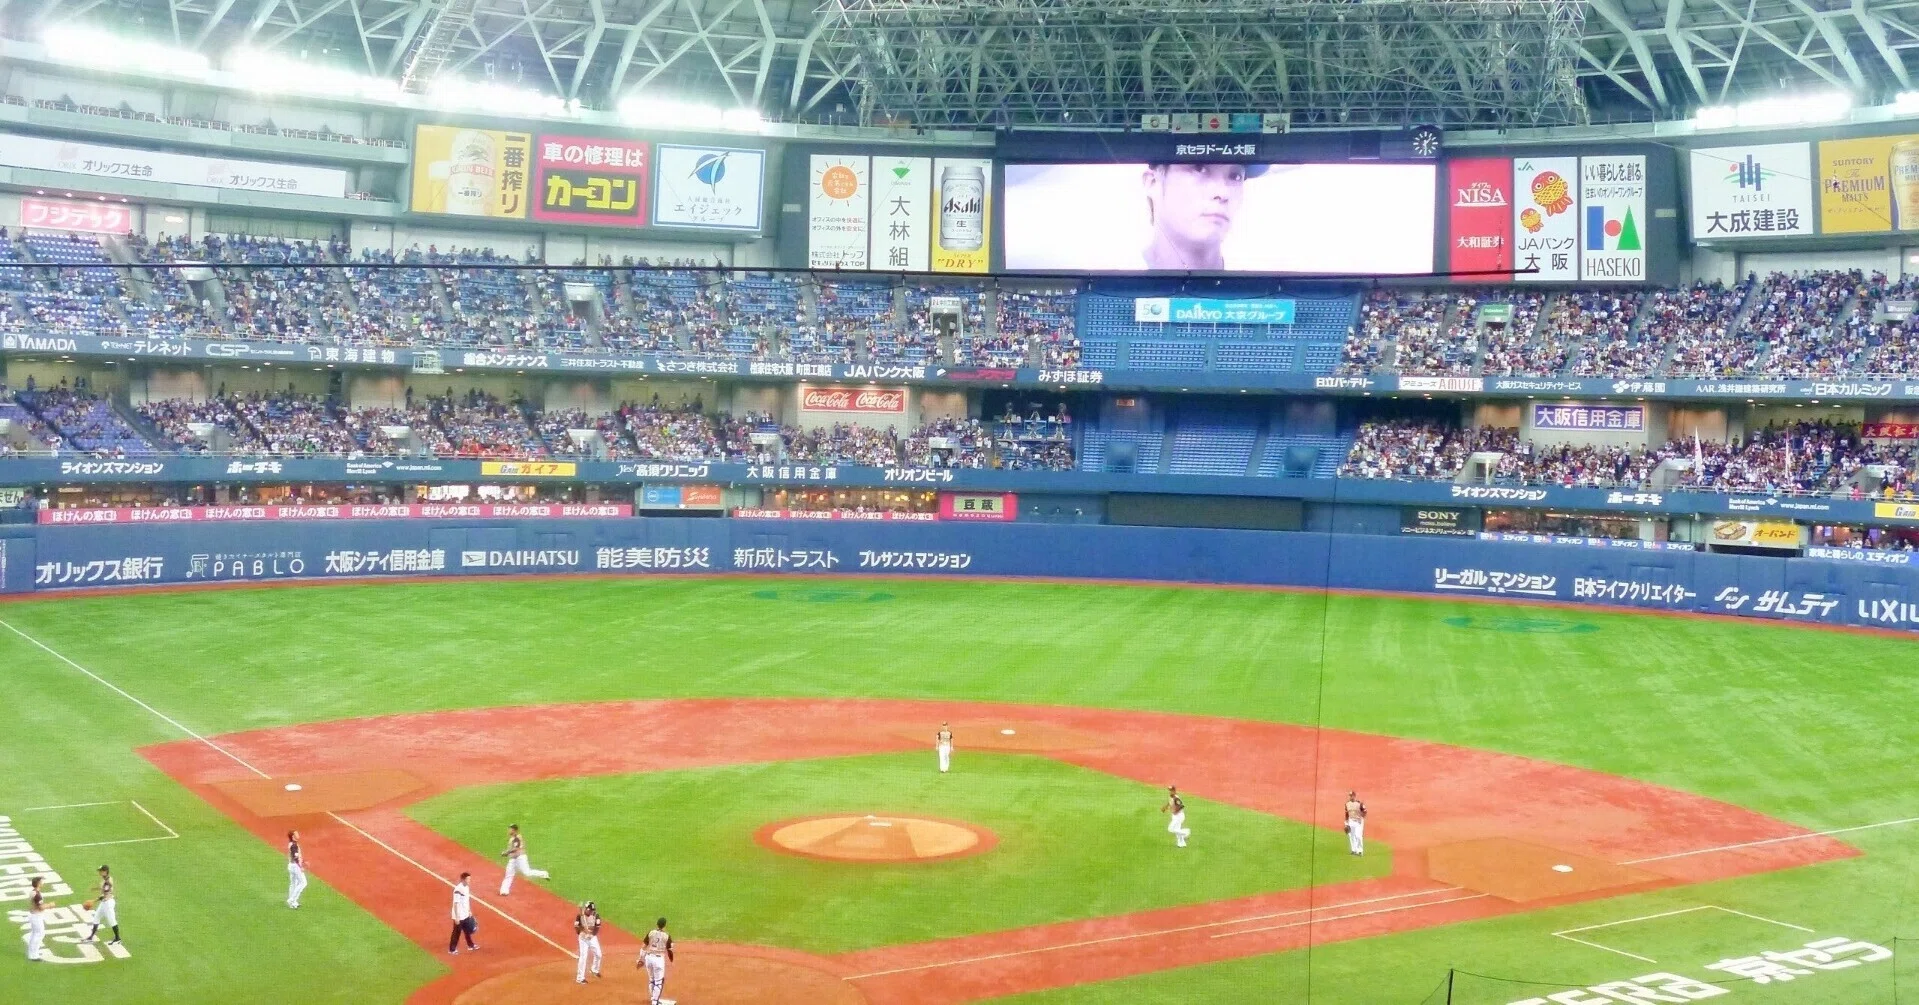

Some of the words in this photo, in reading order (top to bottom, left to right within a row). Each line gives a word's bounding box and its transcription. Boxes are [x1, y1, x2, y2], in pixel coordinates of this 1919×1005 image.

[543, 142, 644, 168] 車の修理は
[82, 159, 153, 177] オリックス生命
[502, 135, 525, 213] 一番搾り
[228, 175, 298, 190] オリックス生命
[1824, 176, 1885, 194] PREMIUM
[547, 175, 636, 210] カーコン
[1457, 188, 1506, 204] NISA
[1733, 193, 1771, 203] TAISEI
[1842, 193, 1869, 203] MALTS
[674, 203, 742, 215] エイジェック
[943, 196, 981, 213] Asahi
[30, 203, 122, 230] フジテック
[1706, 208, 1800, 234] 大成建設
[889, 195, 911, 266] 大林組
[956, 220, 967, 228] 生
[1457, 236, 1504, 249] 大和証券
[1517, 237, 1575, 251] JAバンク
[1524, 252, 1568, 271] 大阪
[1586, 257, 1641, 277] HASEKO
[1225, 311, 1286, 320] 大京グループ
[18, 334, 77, 351] YAMADA
[134, 340, 193, 356] テレネット
[206, 343, 250, 357] CSP
[325, 347, 396, 364] 東海建物
[463, 352, 548, 368] 総合メンテナンス
[560, 358, 645, 370] 三井住友トラスト不動産
[666, 361, 739, 374] さつき株式会社
[844, 365, 925, 379] JAバンク大阪
[1038, 369, 1103, 384] みずほ証券
[1315, 377, 1375, 389] 日立バッテリー
[1402, 380, 1437, 388] アミューズ
[1438, 377, 1478, 391] AMUSE
[1495, 379, 1582, 391] 大阪ガスセキュリティサービス
[1629, 382, 1666, 394] 伊藤園
[1815, 383, 1892, 396] 日本カルミック
[1536, 407, 1642, 428] 大阪信用金庫
[61, 461, 164, 475] ライオンズマンション
[227, 461, 283, 474] ホーチキ
[521, 463, 559, 475] ガイア
[636, 463, 708, 478] 高須クリニック
[746, 466, 837, 480] 大阪信用金庫
[884, 467, 954, 483] オリオンビール
[1451, 485, 1548, 501] ライオンズマンション
[1607, 491, 1663, 506] ホーチキ
[279, 506, 340, 518] ほけんの窓口
[352, 505, 410, 517] ほけんの窓口
[422, 505, 481, 517] ほけんの窓口
[493, 504, 551, 517] ほけんの窓口
[563, 504, 619, 517] ほけんの窓口
[963, 499, 993, 511] 豆蔵
[53, 508, 118, 523] ほけんの窓口
[131, 508, 193, 520] ほけんの窓口
[206, 507, 265, 519] ほけんの窓口
[738, 510, 781, 518] ほけんの窓口
[790, 511, 832, 519] ほけんの窓口
[841, 511, 884, 520] ほけんの窓口
[892, 512, 934, 521] ほけんの窓口
[1417, 510, 1460, 520] SONY
[1502, 534, 1529, 542] エディオン
[1556, 537, 1583, 545] エディオン
[1611, 540, 1639, 548] エディオン
[1666, 543, 1694, 551] エディオン
[325, 549, 445, 573] 大阪シティ信用金庫
[489, 550, 579, 567] DAIHATSU
[596, 547, 710, 569] 能美防災
[733, 547, 840, 569] 新成トラスト
[858, 550, 972, 569] プレサンスマンション
[1866, 551, 1909, 564] エディオン
[36, 556, 164, 584] オリックス銀行
[213, 558, 305, 577] PABLO
[1574, 577, 1697, 603] 日本ライフクリエイター
[1752, 590, 1839, 617] サムティ
[1703, 936, 1894, 985] 京セラ
